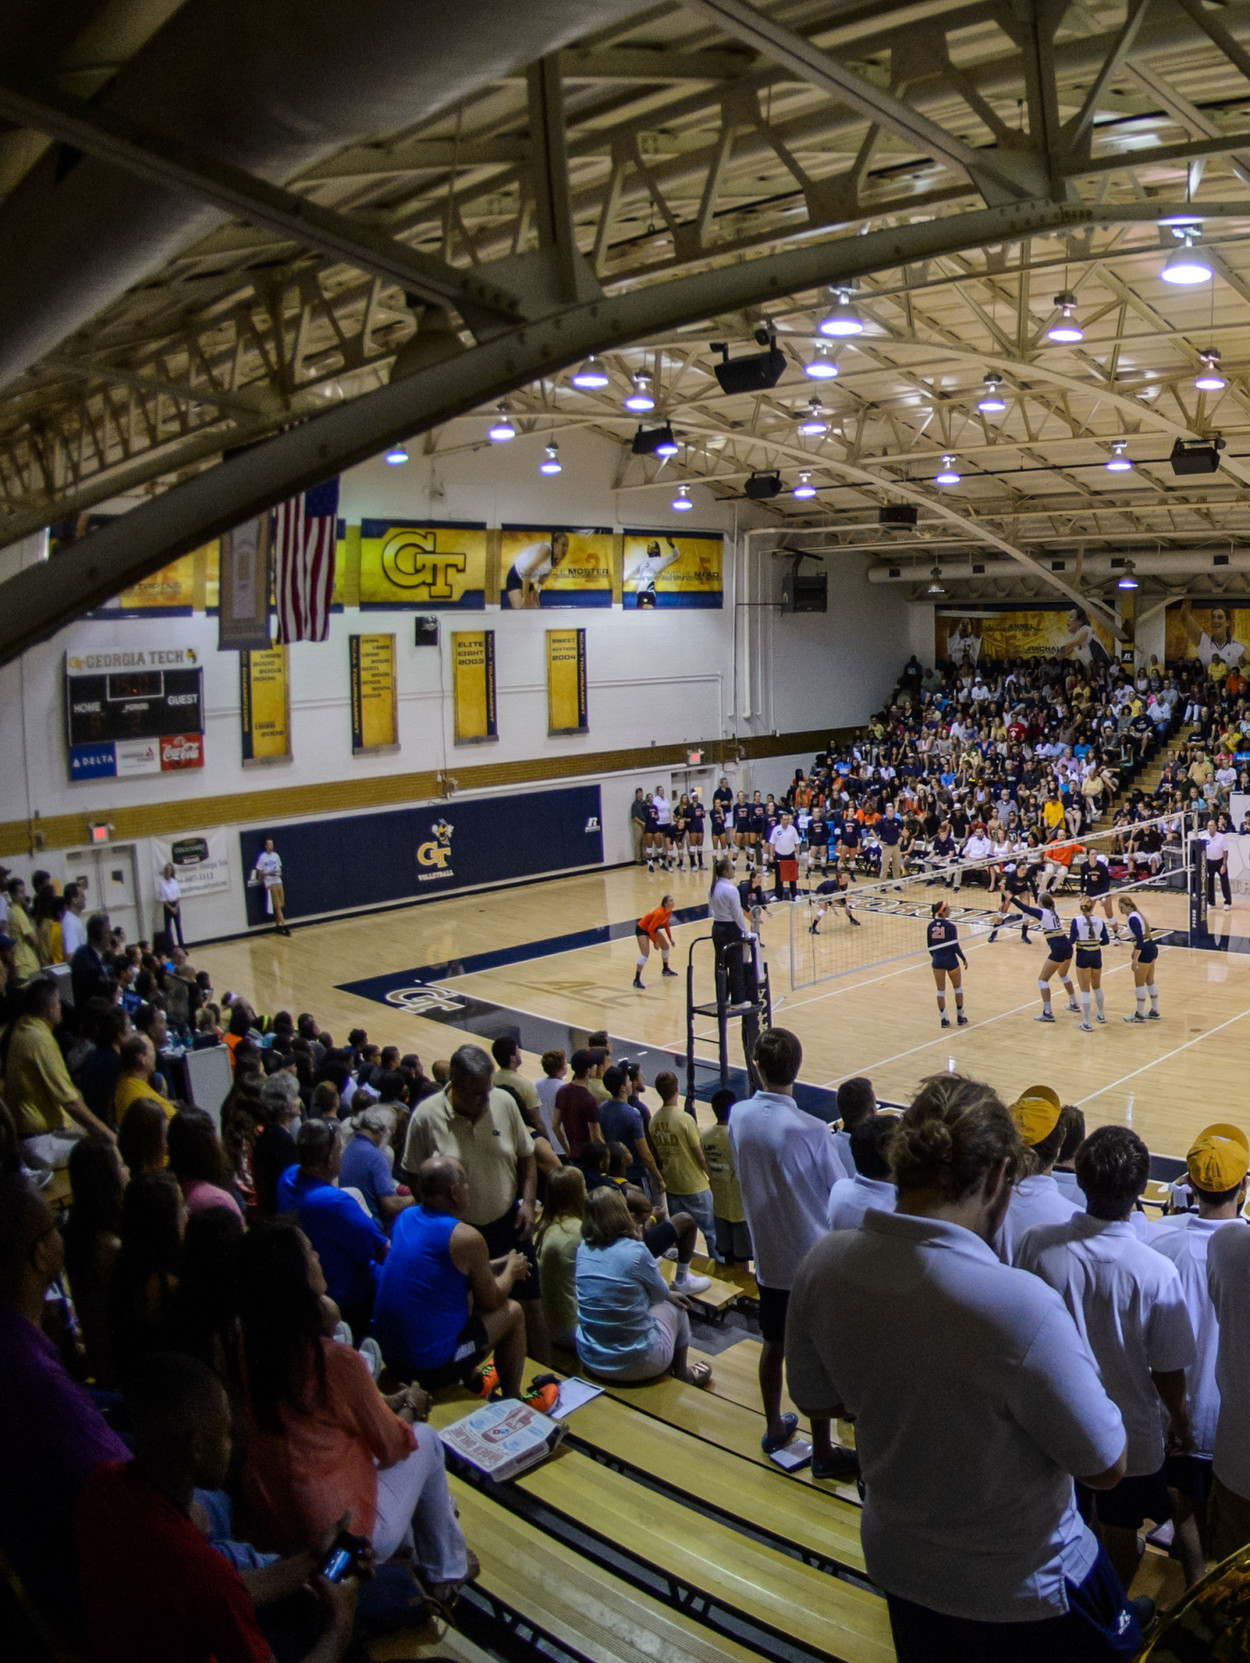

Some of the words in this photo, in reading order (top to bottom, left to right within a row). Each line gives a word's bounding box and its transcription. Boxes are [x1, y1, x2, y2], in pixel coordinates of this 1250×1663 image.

[382, 531, 466, 598] GT
[567, 567, 610, 576] MOSTER
[693, 570, 720, 579] MEAD
[457, 641, 485, 649] ELITE
[86, 652, 146, 669] GEORGIA
[148, 650, 184, 665] TECH
[167, 693, 198, 706] GUEST
[73, 701, 102, 714] HOME
[81, 753, 115, 767] DELTA
[417, 840, 452, 868] GT
[930, 925, 946, 940] 21
[385, 985, 468, 1016] GT
